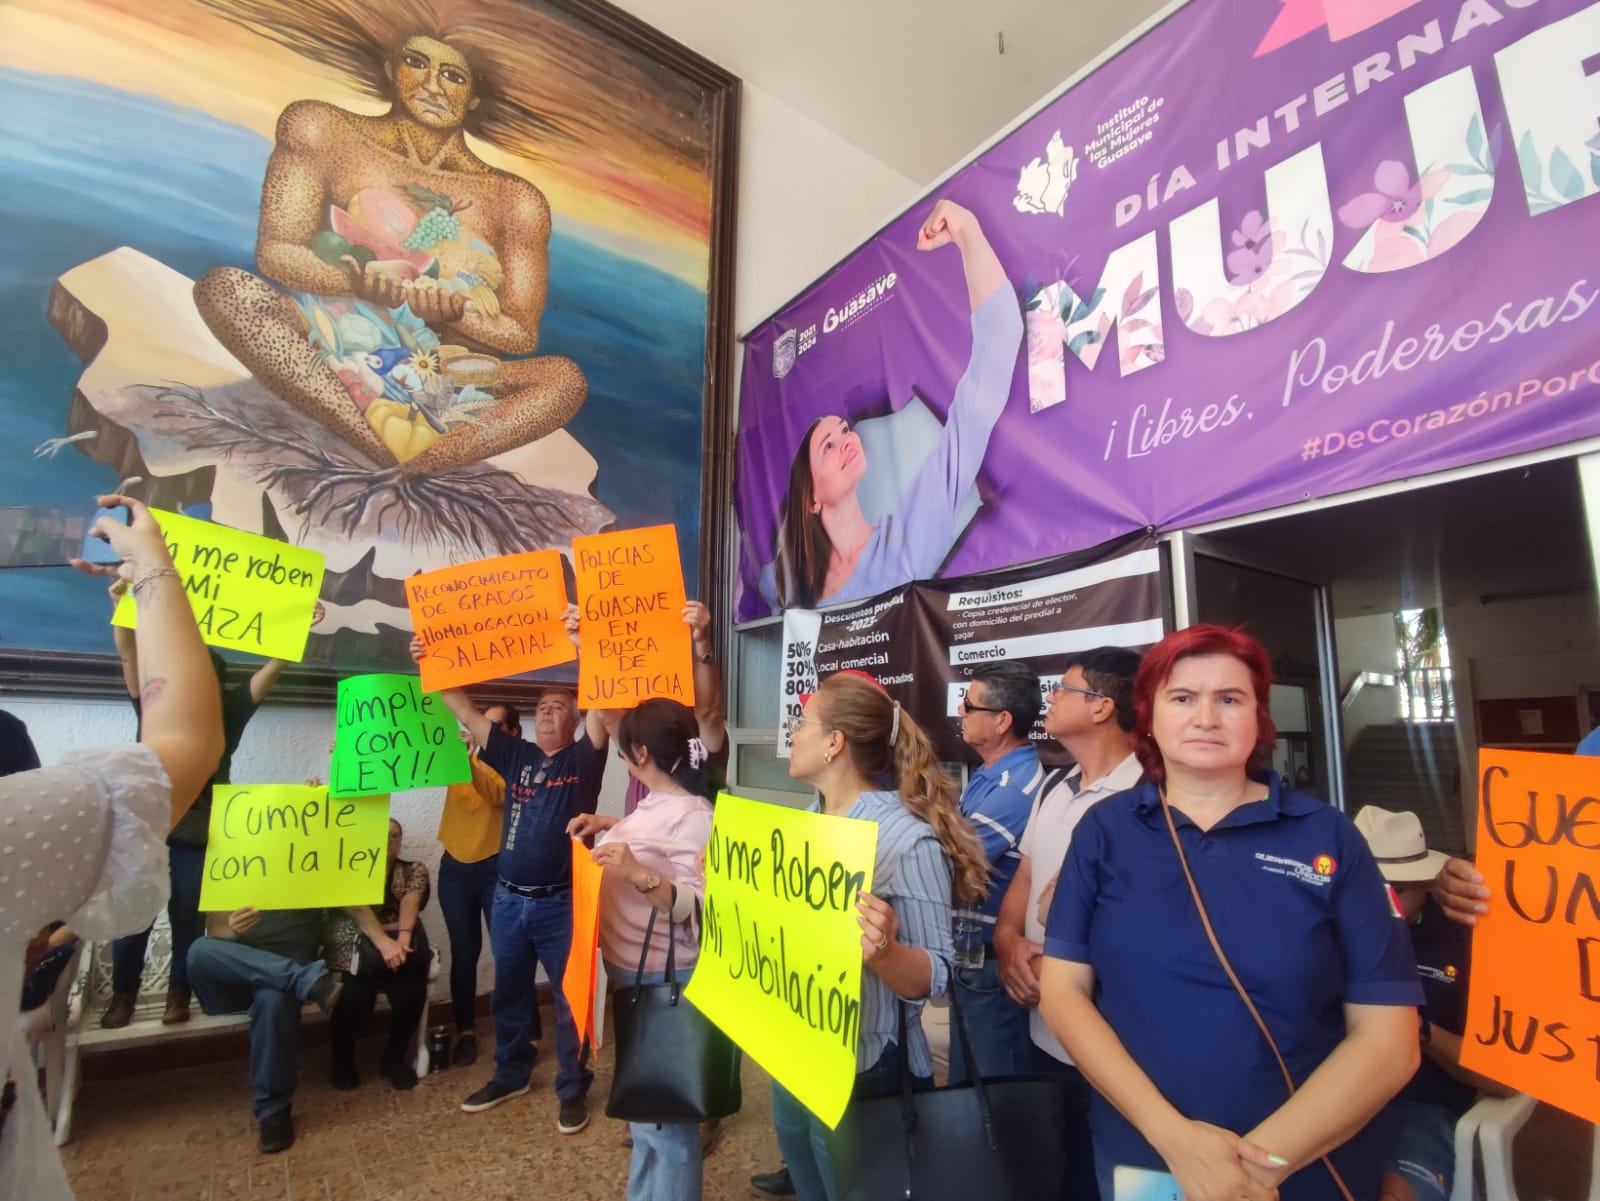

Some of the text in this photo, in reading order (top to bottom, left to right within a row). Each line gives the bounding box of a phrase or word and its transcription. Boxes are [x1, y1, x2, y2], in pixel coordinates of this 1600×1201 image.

[1085, 97, 1164, 156] Municipal de
[1097, 96, 1149, 135] Instituto
[1115, 0, 1540, 228] DÍA INTERNA
[1090, 113, 1160, 163] las Mujeres
[1097, 130, 1153, 169] Guasave
[823, 272, 897, 333] Guasave
[798, 337, 817, 355] 2024
[799, 324, 817, 342] 2021
[1281, 279, 1600, 407] Poderosas
[192, 544, 239, 573] me
[245, 552, 314, 588] roben
[580, 544, 655, 571] POLICIAS
[185, 573, 222, 601] Mi
[412, 567, 550, 603] RECONOCIMIENTO
[598, 570, 625, 590] DE
[421, 585, 535, 619] DE GRADOS
[585, 592, 670, 622] GUASAVE
[959, 589, 1023, 607] Requisitos:
[962, 593, 1078, 621] Copia credencial de elector,
[198, 604, 262, 645] AZA
[608, 620, 638, 636] EN
[824, 606, 873, 624] Descuentos
[952, 607, 1062, 629] con domicilio del predial a
[432, 632, 553, 672] SALARIAL
[599, 637, 658, 659] BUSCA
[787, 631, 890, 658] 50% Casa-habitación
[954, 631, 974, 641] pagar
[619, 655, 646, 672] DE
[786, 658, 815, 677] 30%
[840, 652, 889, 669] comercial
[958, 645, 1006, 661] Comercio
[587, 673, 684, 701] JUSTICIA
[785, 678, 817, 695] 80%
[338, 682, 436, 728] Cumple
[356, 722, 445, 756] con la
[336, 750, 435, 793] LEY!!
[224, 790, 356, 839] Cumple
[209, 837, 380, 881] con la ley
[726, 836, 761, 892] me
[771, 828, 865, 912] Roben
[704, 894, 859, 1054] Mi Jubilación
